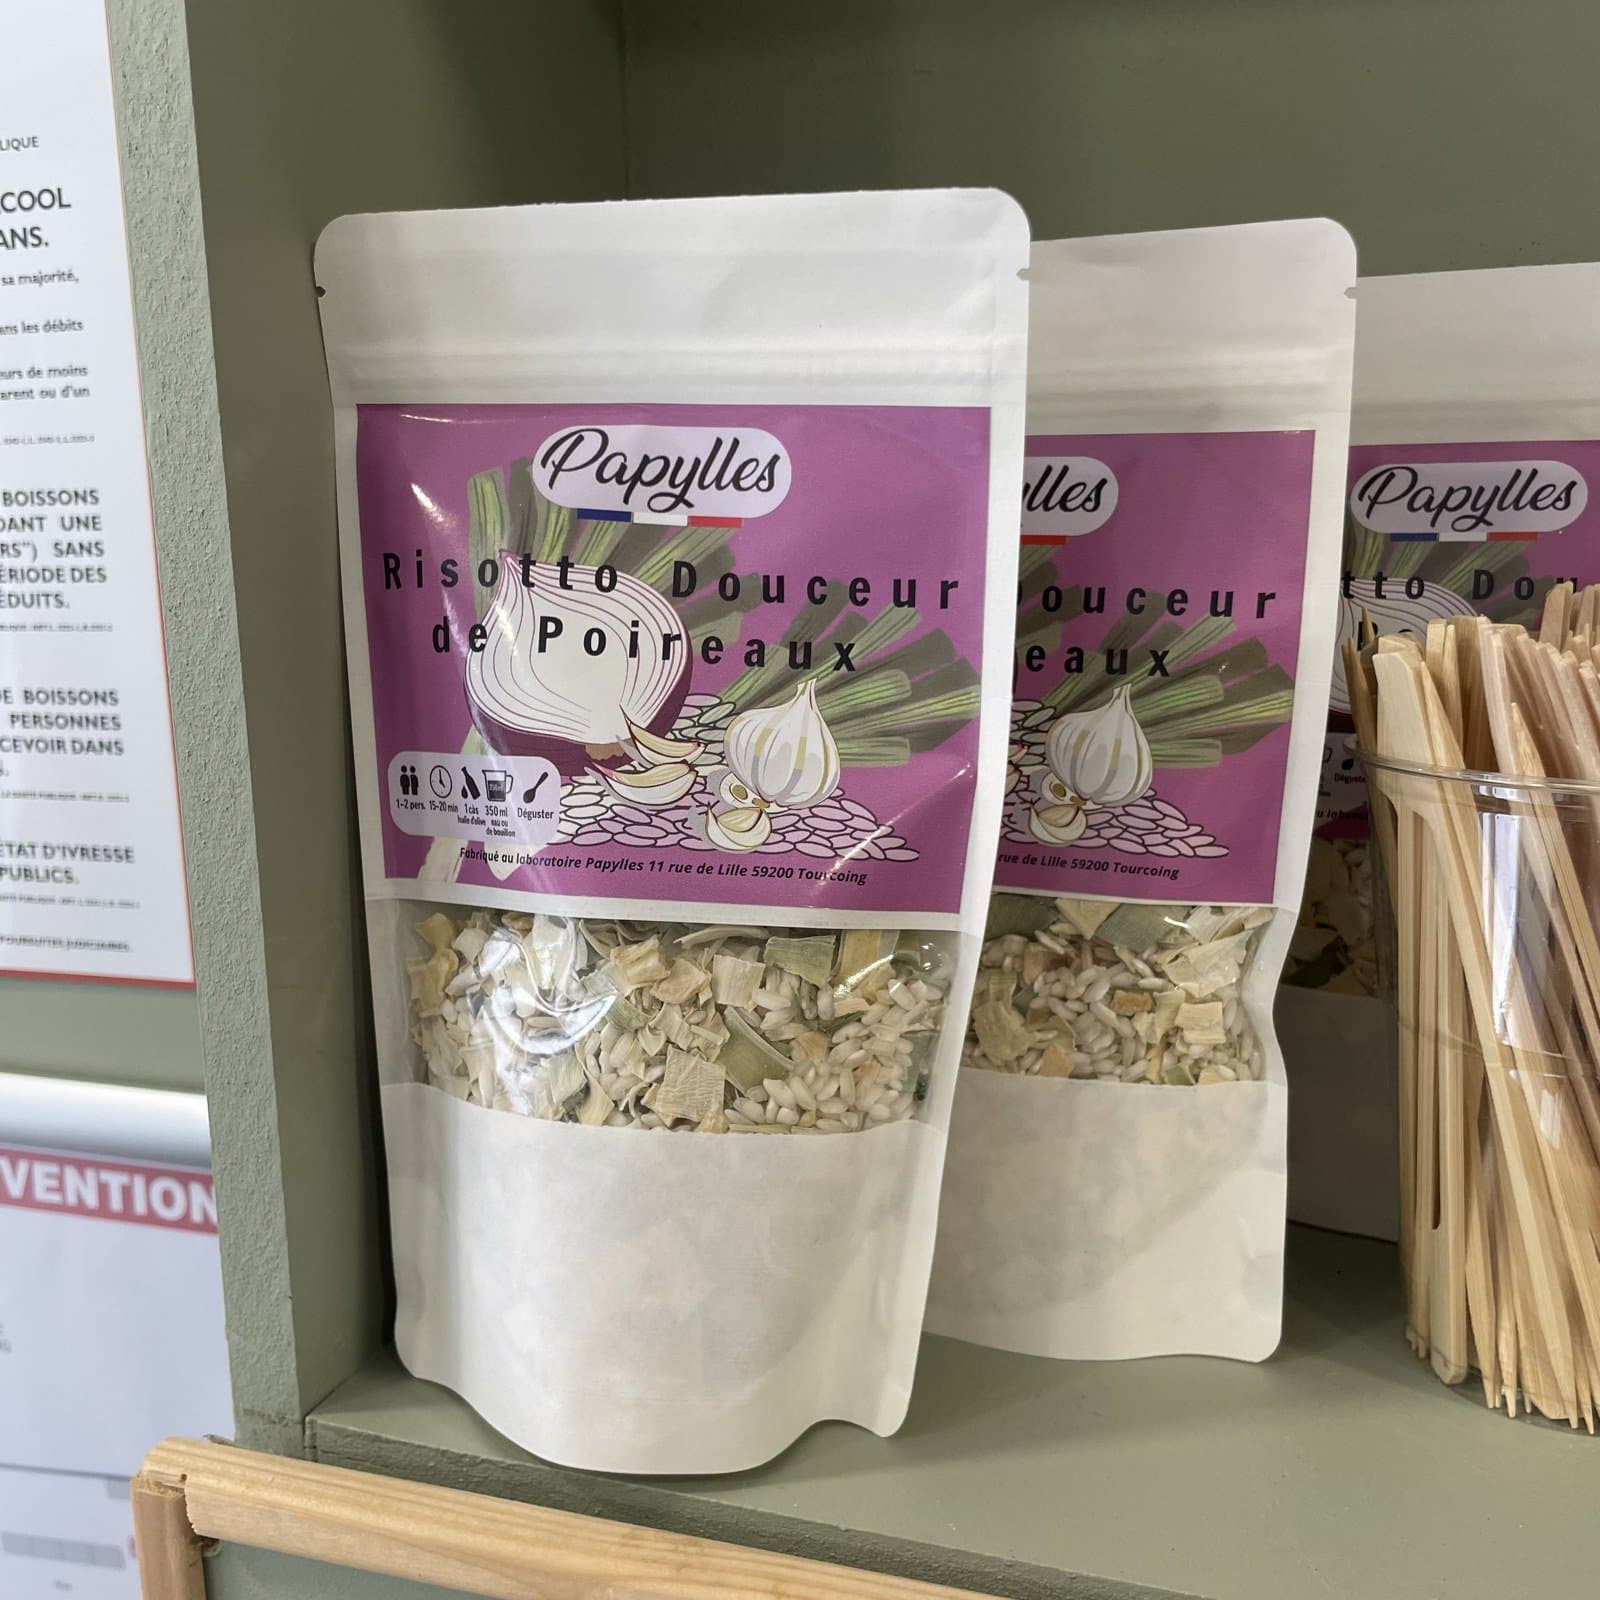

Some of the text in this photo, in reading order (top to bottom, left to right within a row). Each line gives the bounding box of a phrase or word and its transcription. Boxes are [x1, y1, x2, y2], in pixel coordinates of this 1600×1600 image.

[0, 187, 71, 213] COOL
[2, 267, 79, 286] sa majorité,
[22, 321, 39, 333] les
[43, 318, 83, 333] débits
[27, 365, 43, 379] de
[47, 365, 88, 378] moins
[39, 387, 56, 399] ou
[61, 384, 90, 398] d'un
[541, 428, 780, 513] Papylles
[1022, 465, 1108, 512] lles
[3, 489, 100, 507] BOISSONS
[1358, 466, 1577, 532] Papylles
[61, 515, 102, 531] UNE
[53, 541, 104, 557] SANS
[71, 567, 107, 583] DES
[383, 549, 959, 609] Risotto Douceur
[1472, 569, 1578, 600] Do
[1017, 585, 1276, 619] ouceur
[432, 616, 856, 672] de Poireaux
[1026, 644, 1170, 677] eaux
[24, 688, 119, 706] BOISSONS
[10, 713, 122, 731] PERSONNES
[71, 739, 124, 756] DANS
[429, 801, 458, 813] 15-20 min
[485, 805, 508, 817] 350 ml
[518, 808, 554, 820] Déguster
[43, 843, 135, 863] D'IVRESSE
[460, 847, 499, 864] Fabriqué
[501, 853, 513, 864] au
[516, 853, 582, 868] laboratoire
[585, 857, 644, 872] Papylles
[648, 861, 664, 872] 11
[668, 863, 692, 873] rue
[696, 863, 714, 874] de
[718, 863, 748, 876] Lille
[751, 866, 794, 879] 59200
[998, 853, 1180, 881] rue de Lille 59200 Tourcoing
